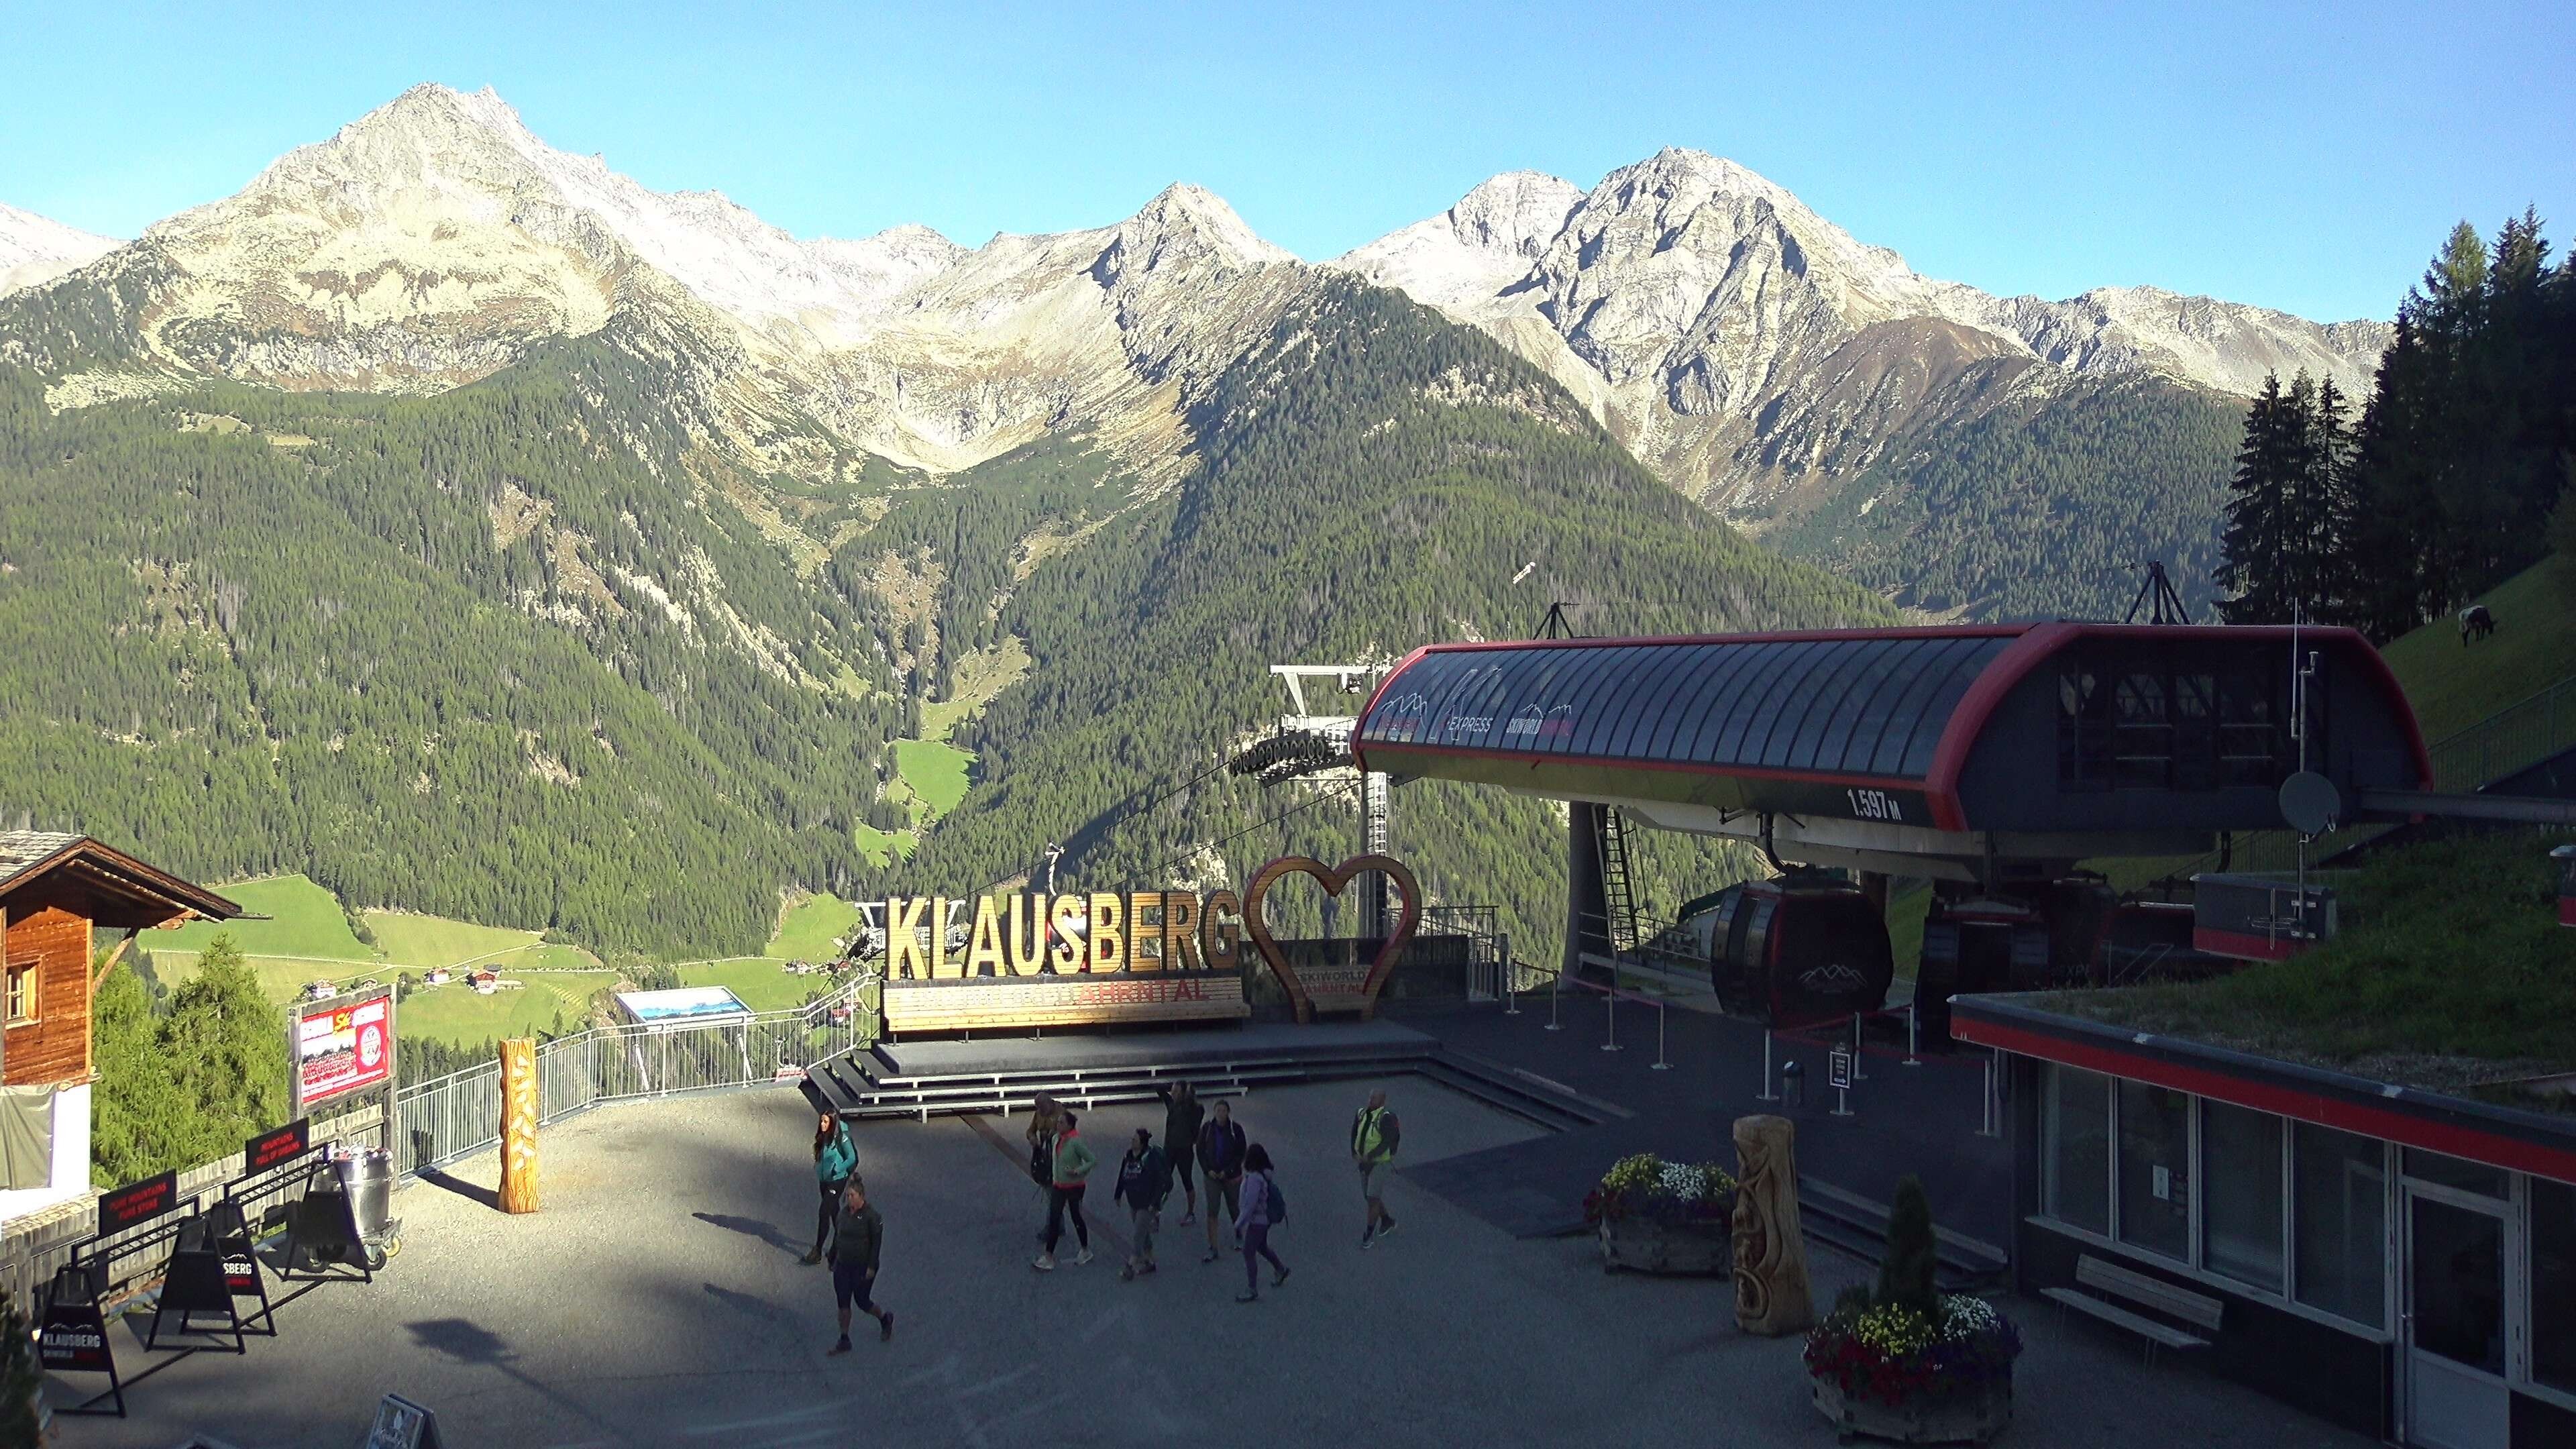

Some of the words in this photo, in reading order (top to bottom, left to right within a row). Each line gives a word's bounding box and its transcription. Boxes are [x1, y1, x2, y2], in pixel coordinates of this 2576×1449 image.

[1448, 716, 1494, 733] EXPRESS
[1847, 788, 1888, 819] 1.597
[885, 891, 1240, 981] KLAUSBERG
[1078, 979, 1210, 1006] AHRNTAL
[42, 1333, 101, 1348] KLAUSBERG
